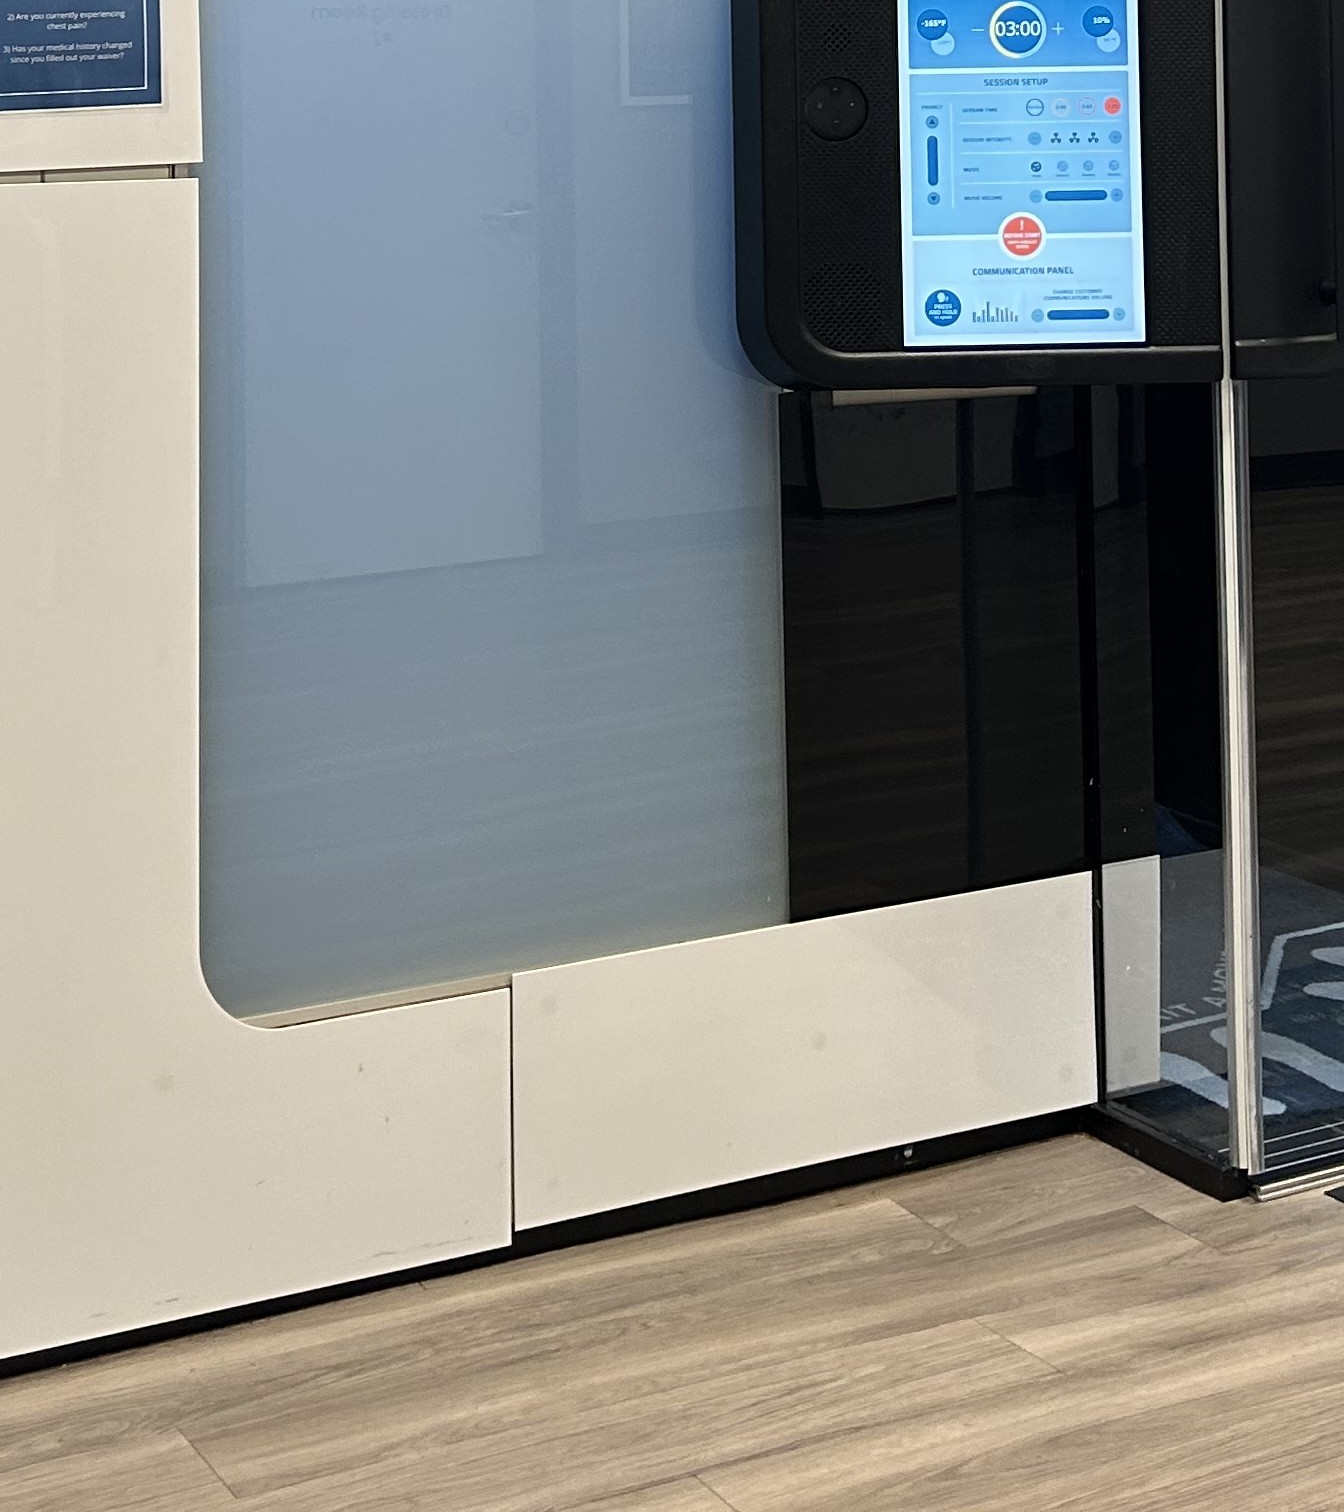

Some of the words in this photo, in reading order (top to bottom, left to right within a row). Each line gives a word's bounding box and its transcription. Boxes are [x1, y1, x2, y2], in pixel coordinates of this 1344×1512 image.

[30, 13, 45, 22] you
[45, 12, 78, 21] currently
[79, 11, 126, 19] experiencing
[995, 20, 1041, 37] 03:00
[11, 45, 27, 53] Has
[26, 45, 45, 54] your
[75, 42, 101, 51] history
[30, 57, 45, 65] you
[65, 54, 78, 62] out
[78, 54, 96, 63] your
[983, 78, 1020, 87] SESSION
[1021, 78, 1048, 86] SETUP
[972, 267, 1045, 276] COMMUNICATION
[1047, 267, 1074, 275] PANEL
